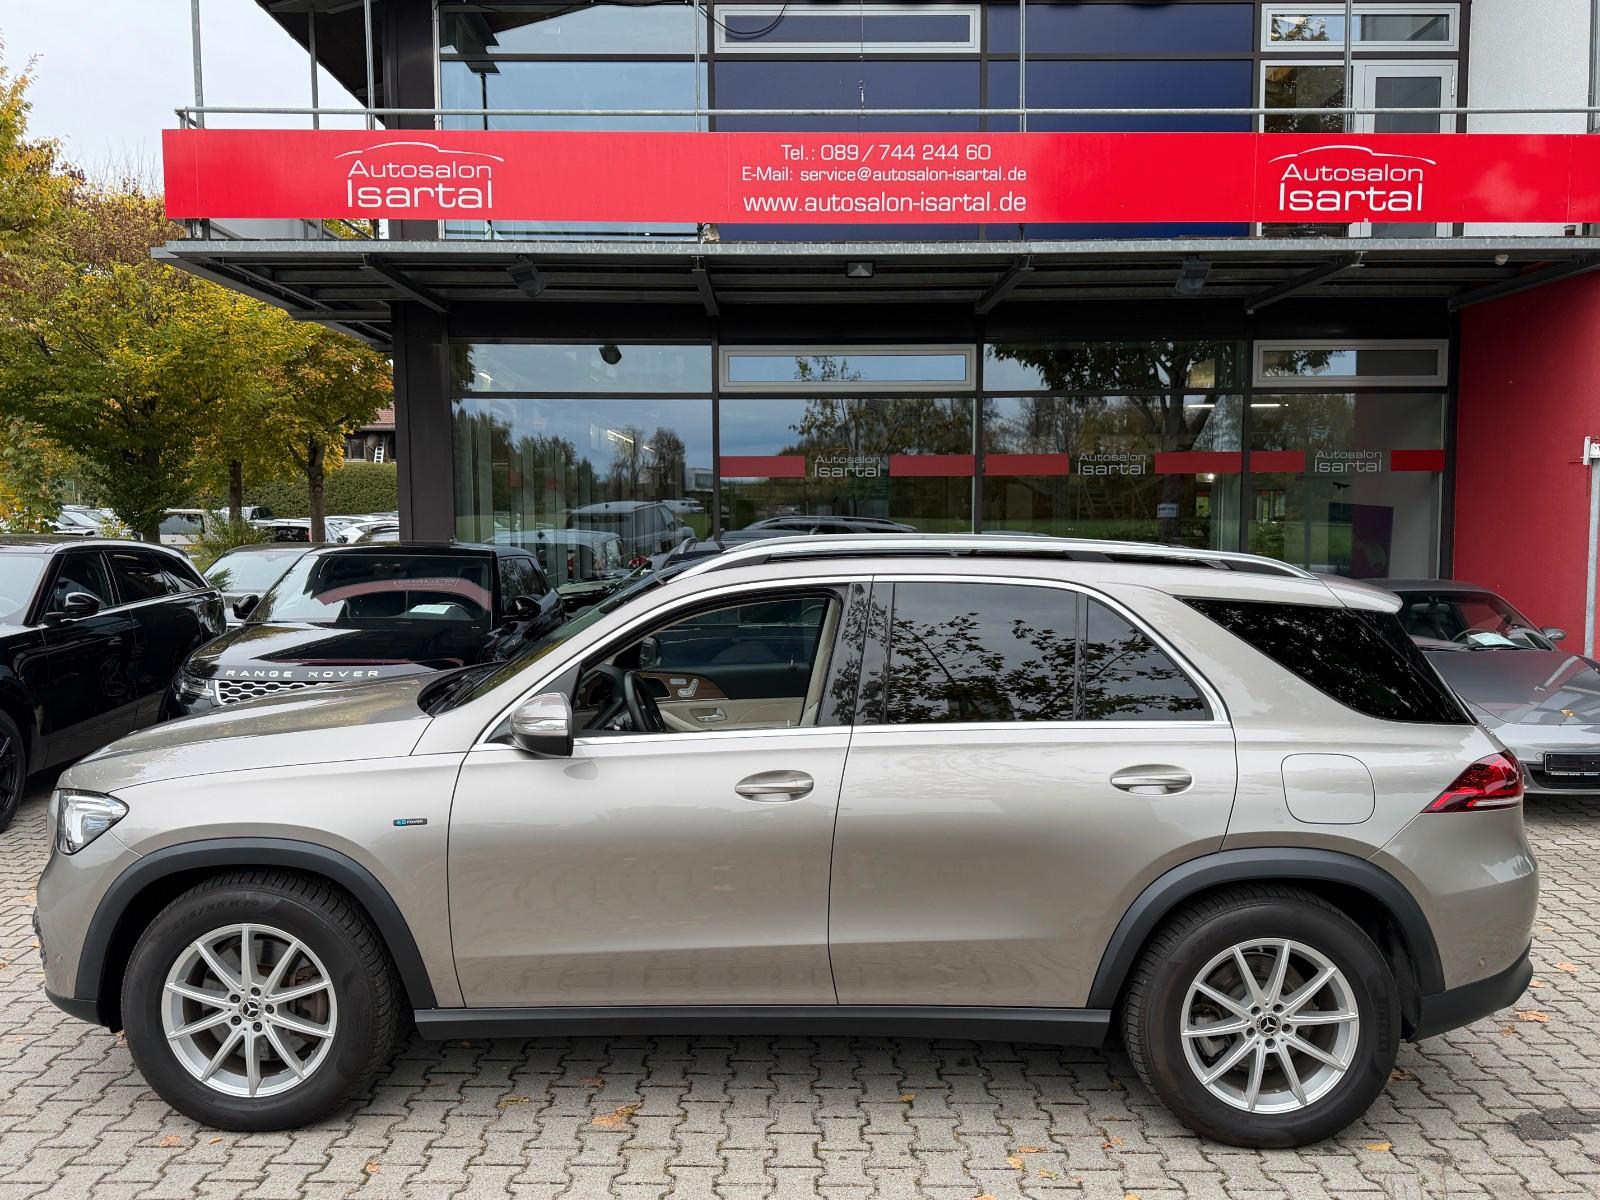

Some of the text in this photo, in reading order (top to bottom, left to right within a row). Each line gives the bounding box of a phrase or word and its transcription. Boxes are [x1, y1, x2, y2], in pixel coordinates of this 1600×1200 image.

[780, 144, 815, 161] Tel.:
[879, 144, 916, 161] 744
[922, 144, 959, 161] 244
[966, 144, 991, 161] 60
[348, 159, 492, 178] Autosalon
[741, 166, 1027, 181] E-Mail: service@autosalon-isartal.de
[1280, 163, 1424, 182] Autosalon
[347, 179, 493, 209] Isartal
[1279, 183, 1423, 211] Isartal
[743, 191, 1027, 213] www.autosalon-isartal.de
[814, 454, 881, 464] Autosalon
[1078, 452, 1146, 462] Autosalon
[1315, 449, 1382, 459] Autosalon
[814, 463, 881, 478] Isartal
[1077, 461, 1146, 476] Isartal
[1314, 459, 1382, 473] Isartal
[225, 669, 380, 679] RANGE ROVER
